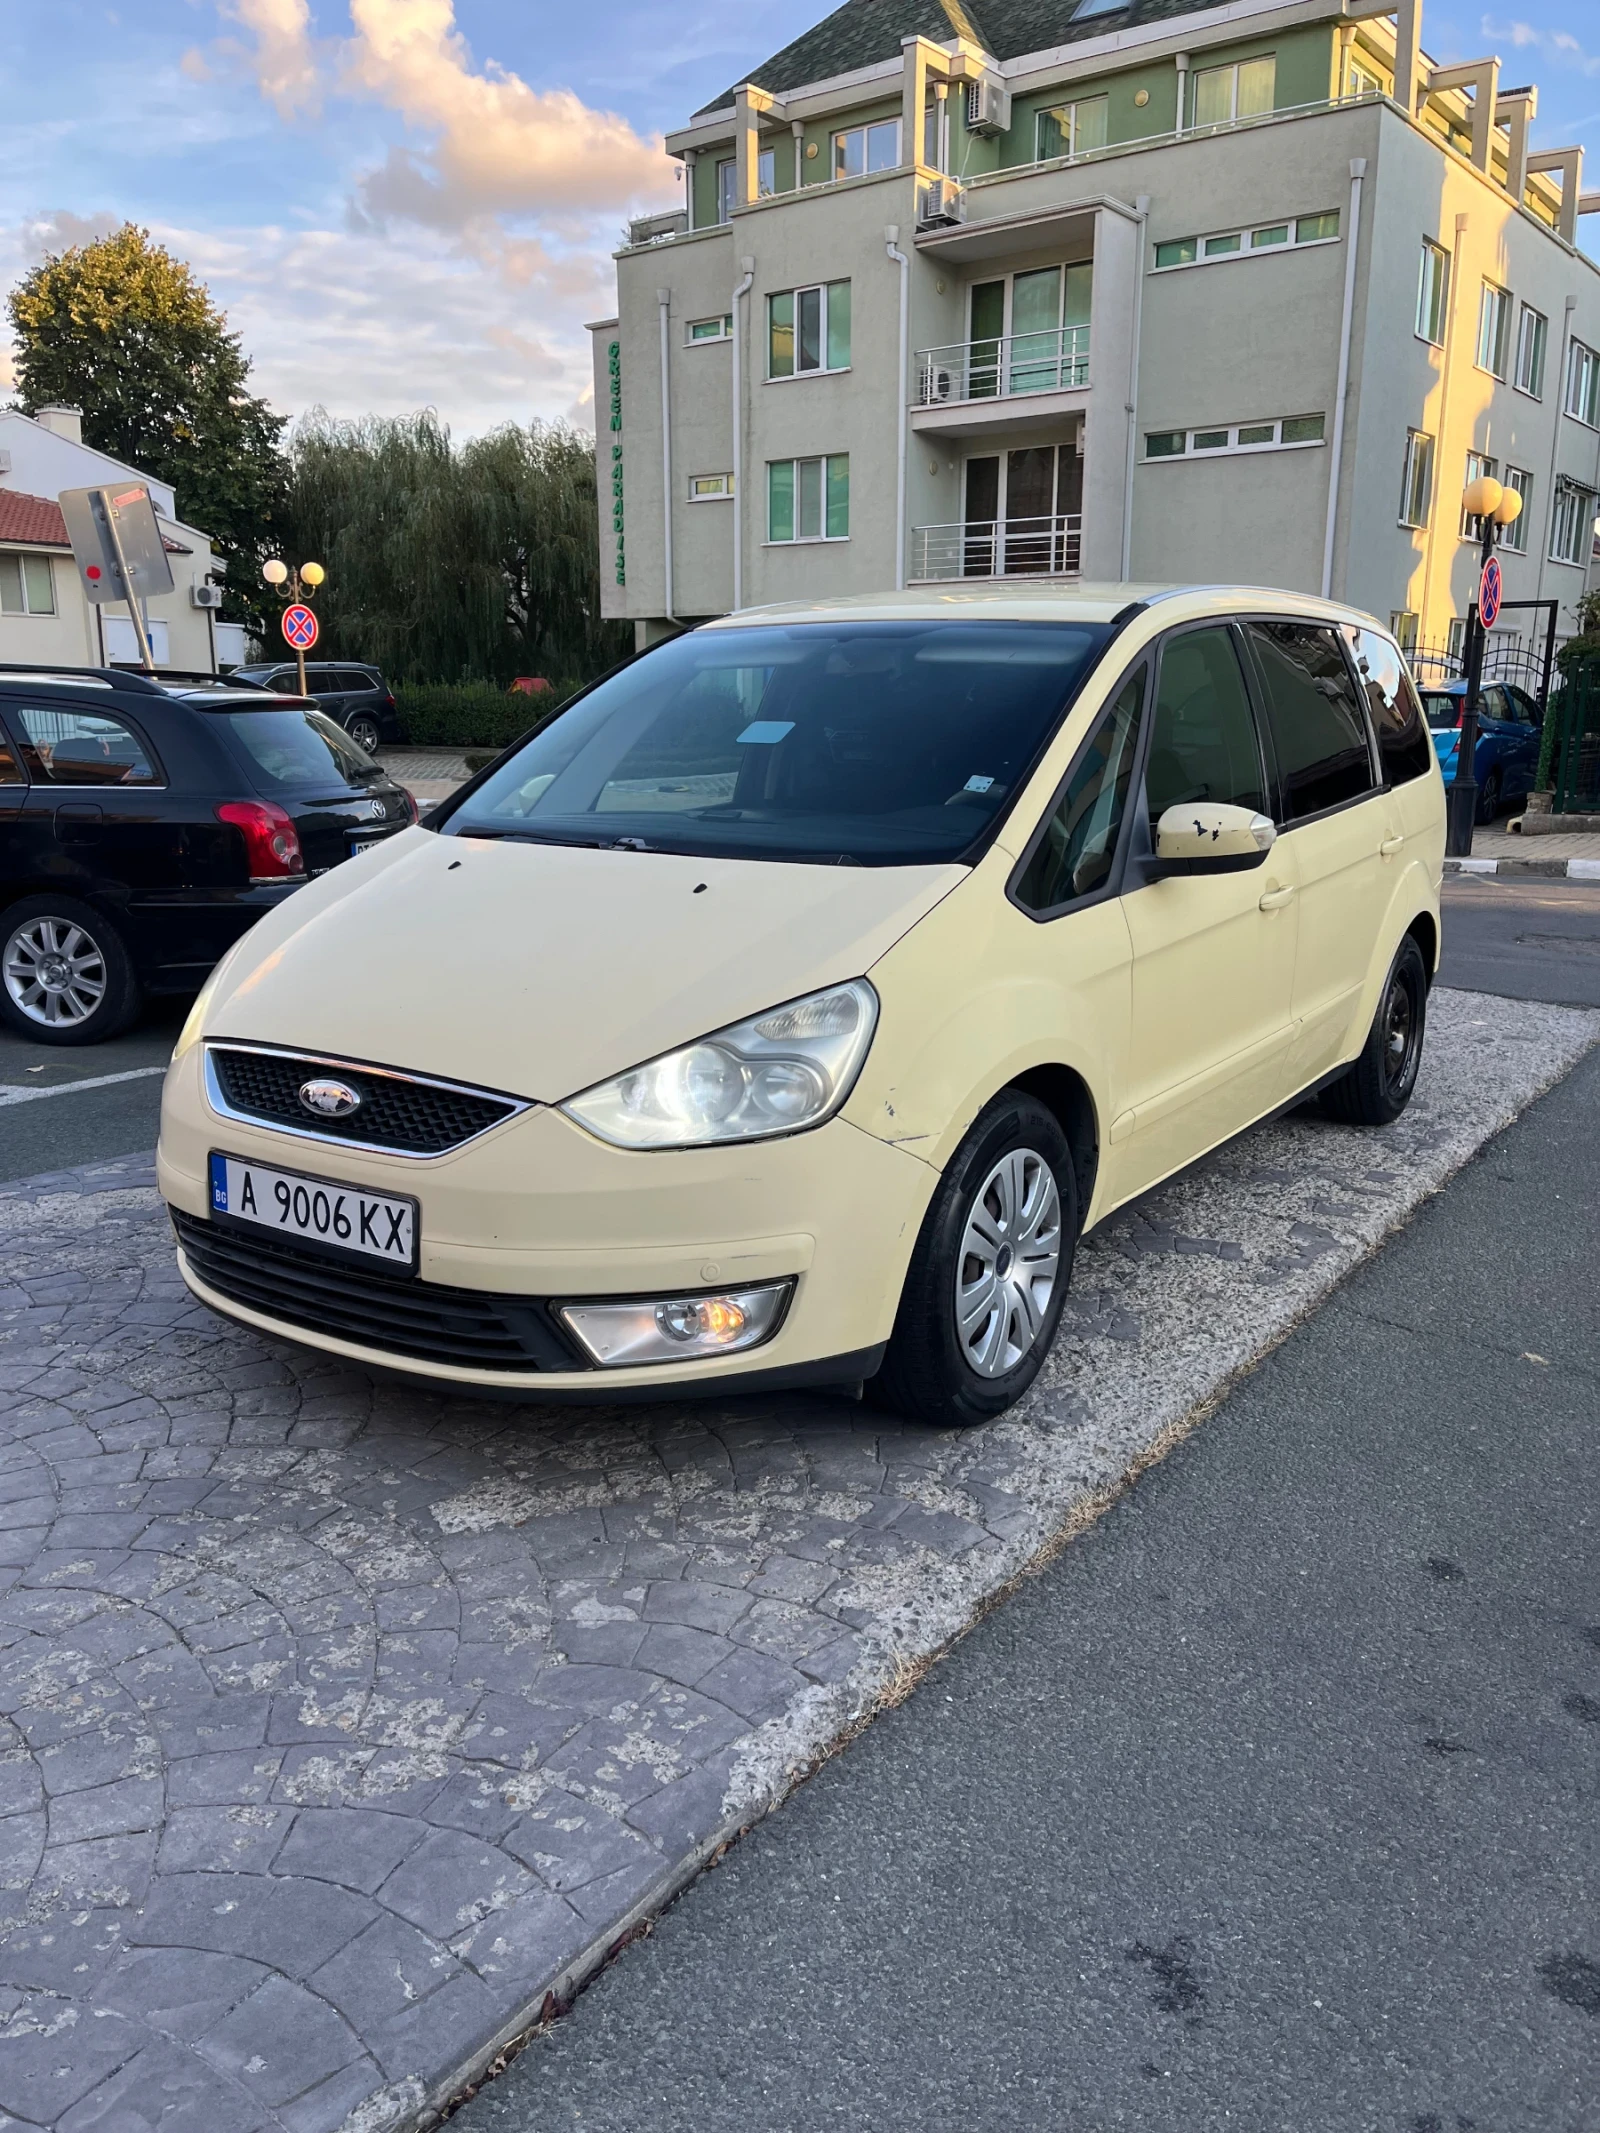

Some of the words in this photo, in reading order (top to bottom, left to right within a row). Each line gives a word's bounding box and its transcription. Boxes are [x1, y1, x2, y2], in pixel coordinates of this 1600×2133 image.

[608, 341, 622, 431] GREEN
[611, 445, 625, 586] PARADISE
[215, 1189, 227, 1204] BG
[241, 1171, 258, 1215] A
